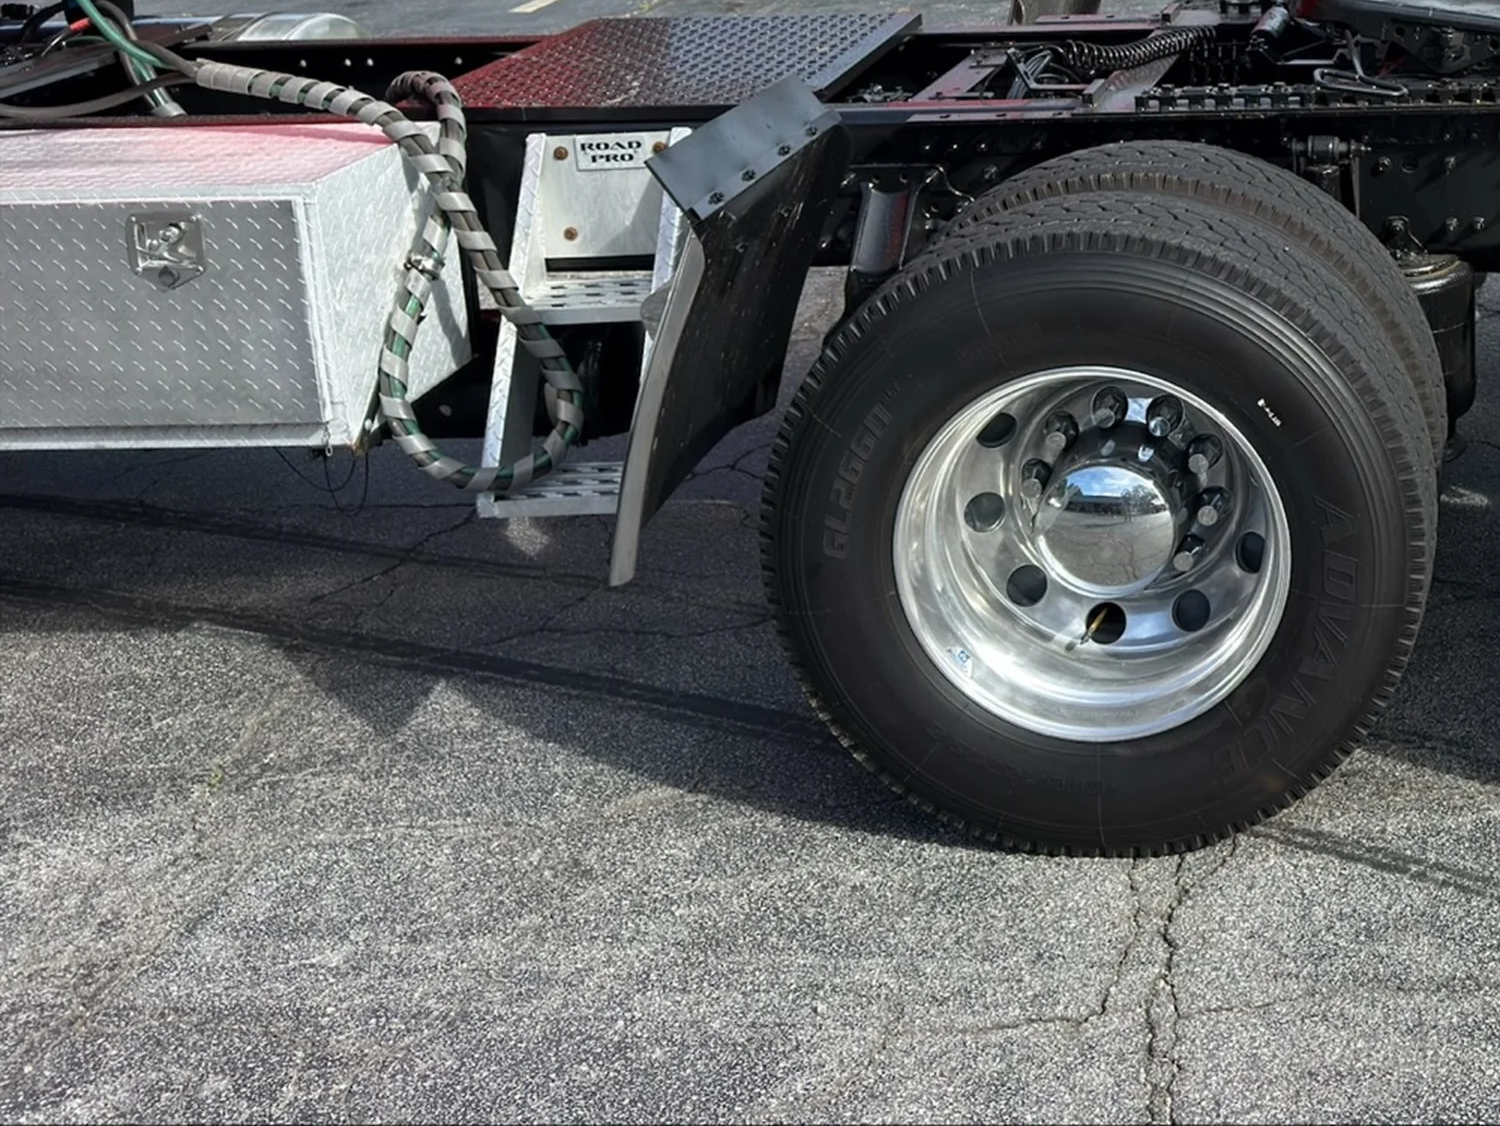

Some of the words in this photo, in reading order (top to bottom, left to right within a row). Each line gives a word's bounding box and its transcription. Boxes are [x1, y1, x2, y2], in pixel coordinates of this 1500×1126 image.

[580, 140, 642, 152] ROAD
[591, 153, 634, 164] PRO
[1211, 494, 1359, 779] ADVANCE
